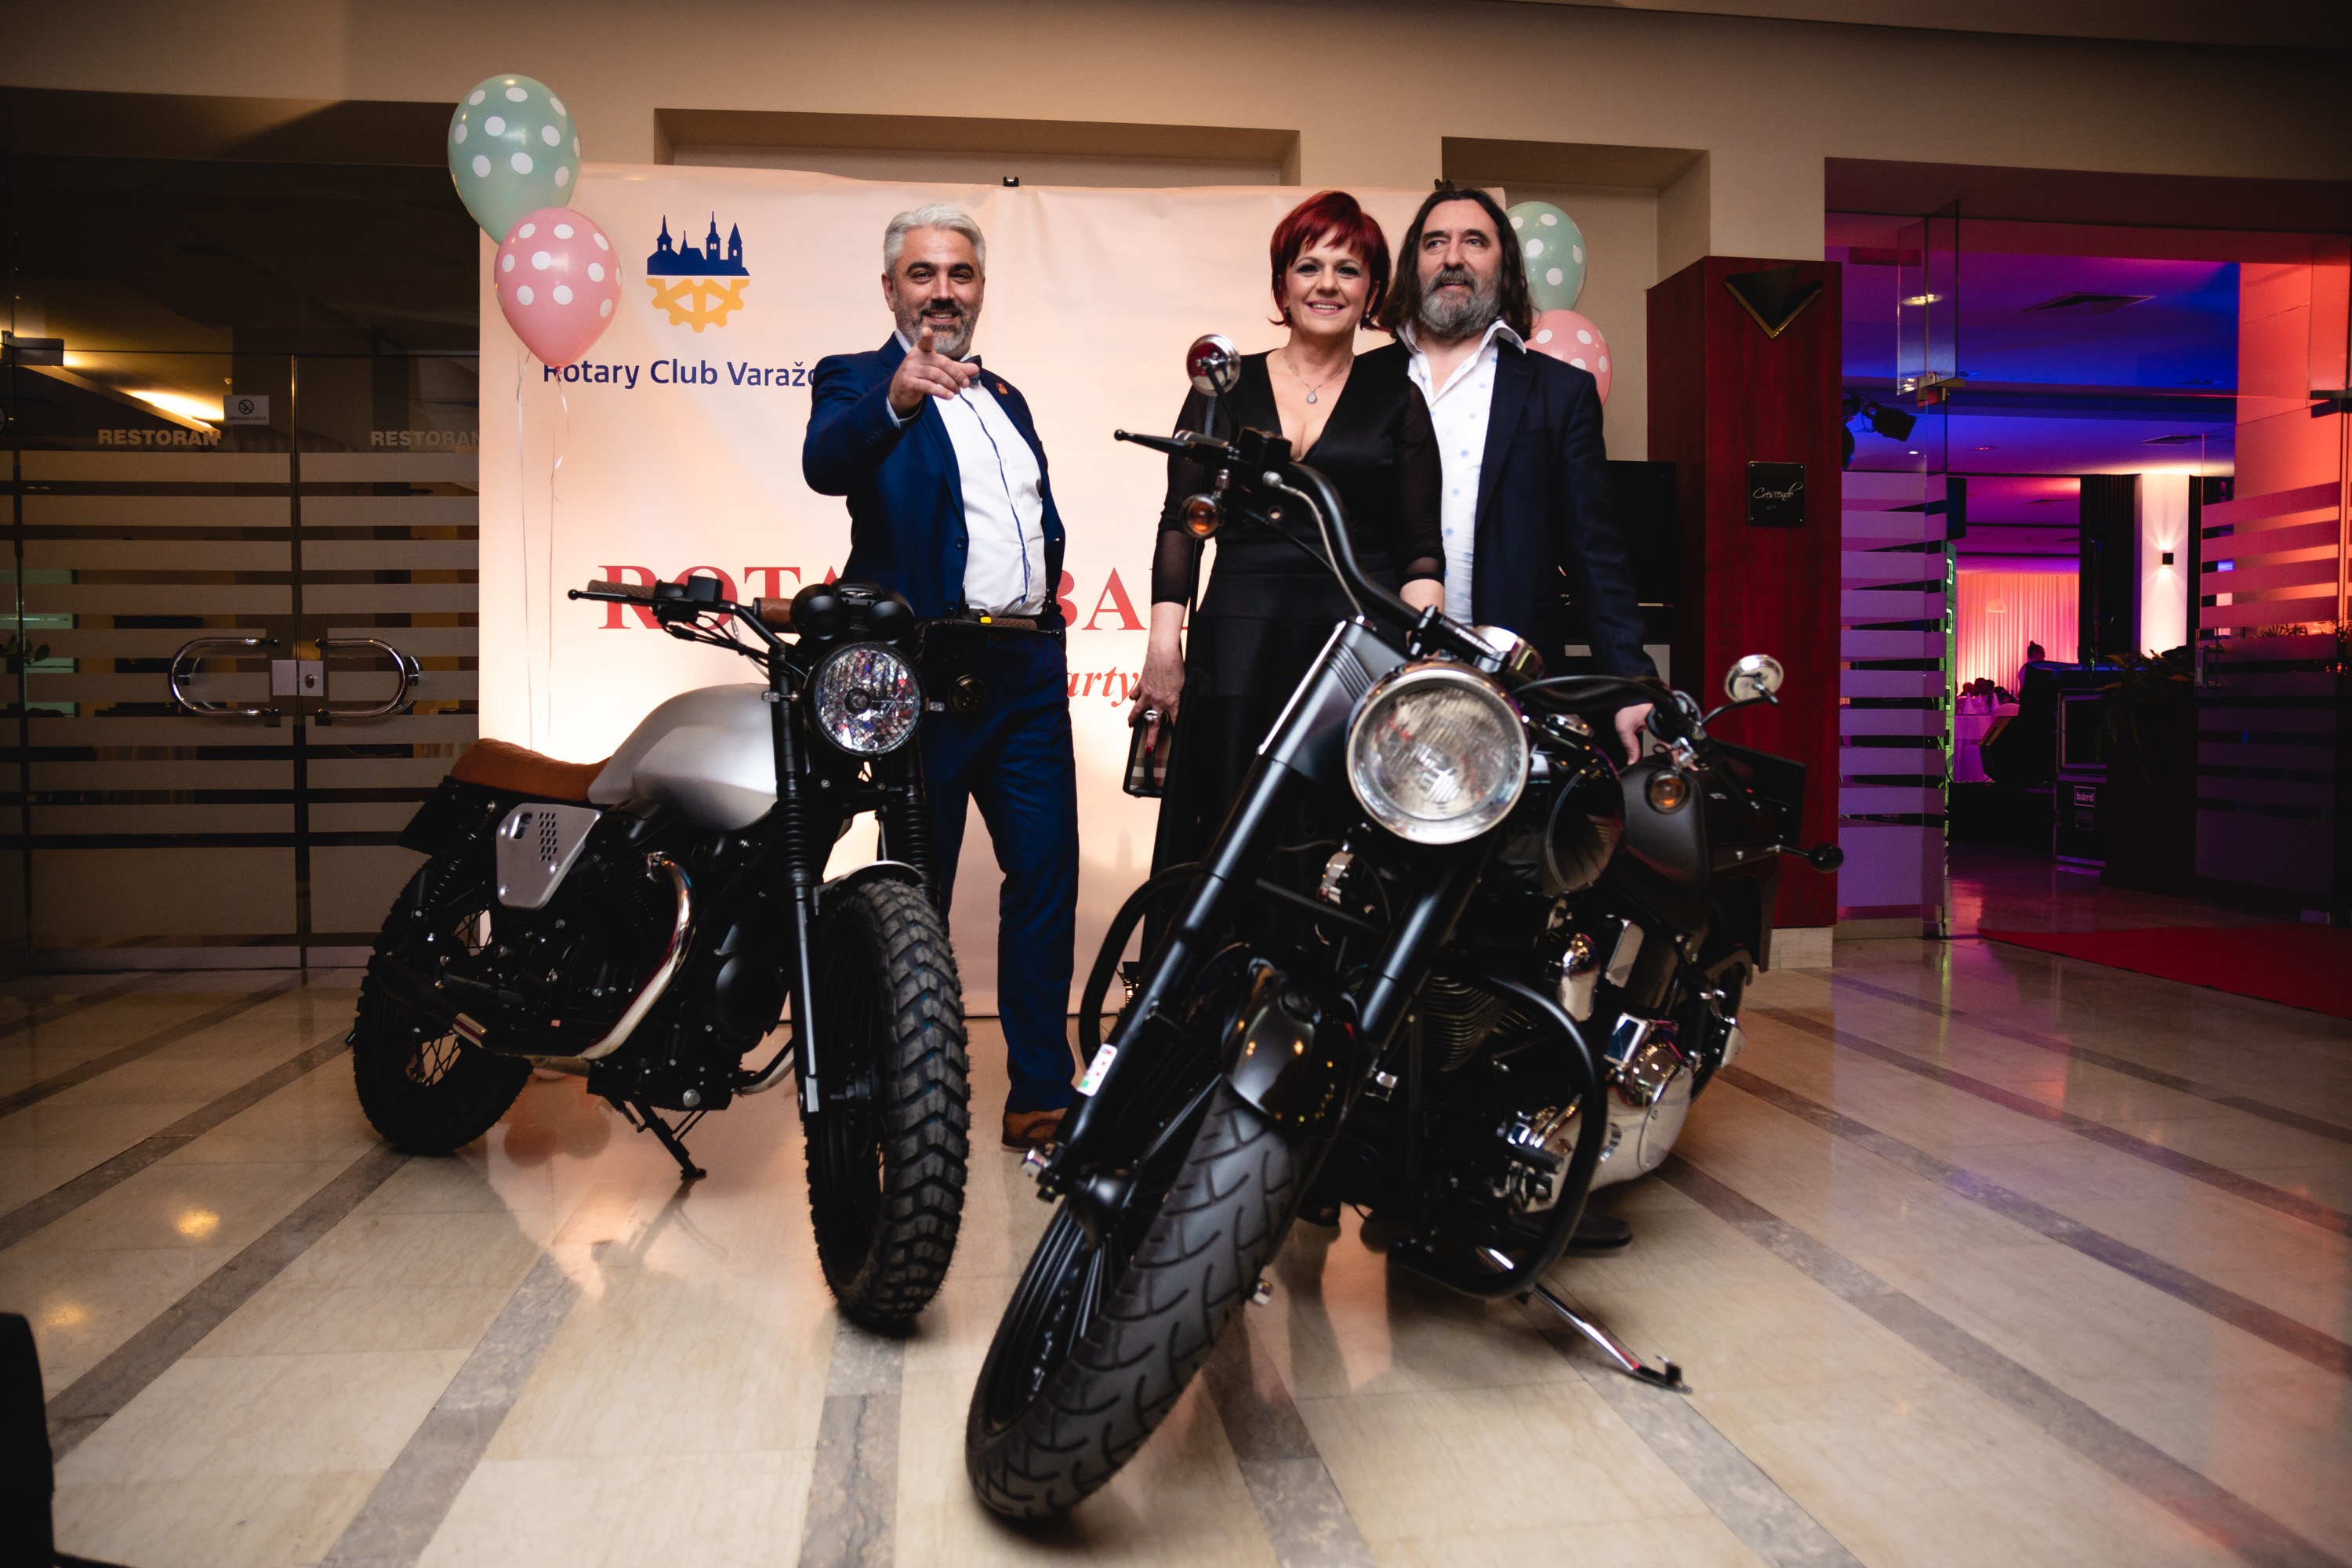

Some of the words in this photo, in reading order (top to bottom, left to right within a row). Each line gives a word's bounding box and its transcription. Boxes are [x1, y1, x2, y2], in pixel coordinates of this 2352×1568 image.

[650, 359, 717, 385] Club
[98, 429, 218, 446] RESTORAN
[2076, 792, 2093, 801] bard
